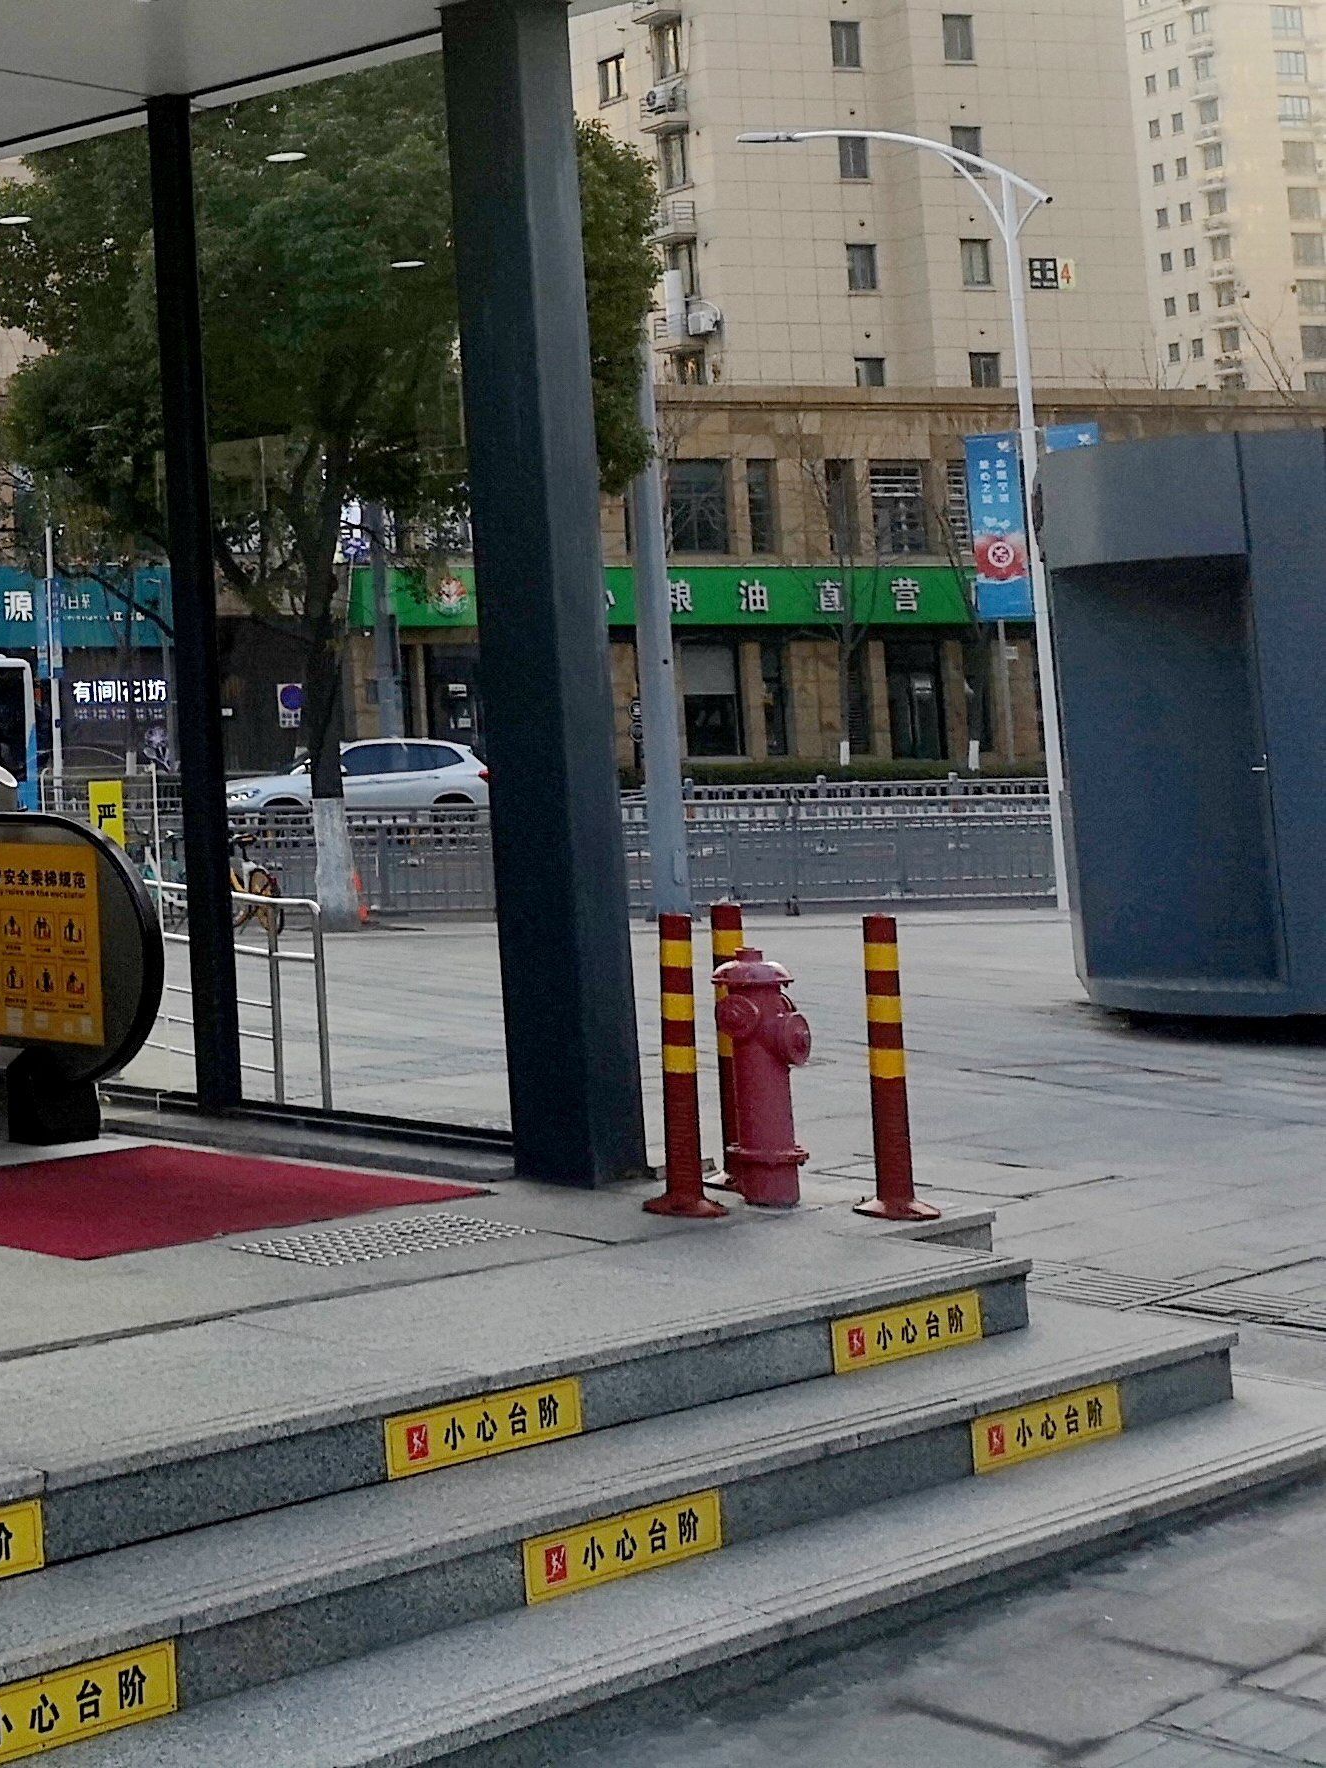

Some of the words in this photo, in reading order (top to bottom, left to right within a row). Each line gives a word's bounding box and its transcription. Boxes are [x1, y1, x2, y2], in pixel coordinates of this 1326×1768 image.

[1061, 262, 1071, 284] 4
[605, 577, 920, 613] 粮油直营
[877, 1304, 964, 1351] 小心台阶
[445, 1394, 559, 1451] 小心台阶
[1017, 1398, 1103, 1448] 小心台阶
[583, 1508, 699, 1572] 小心台阶
